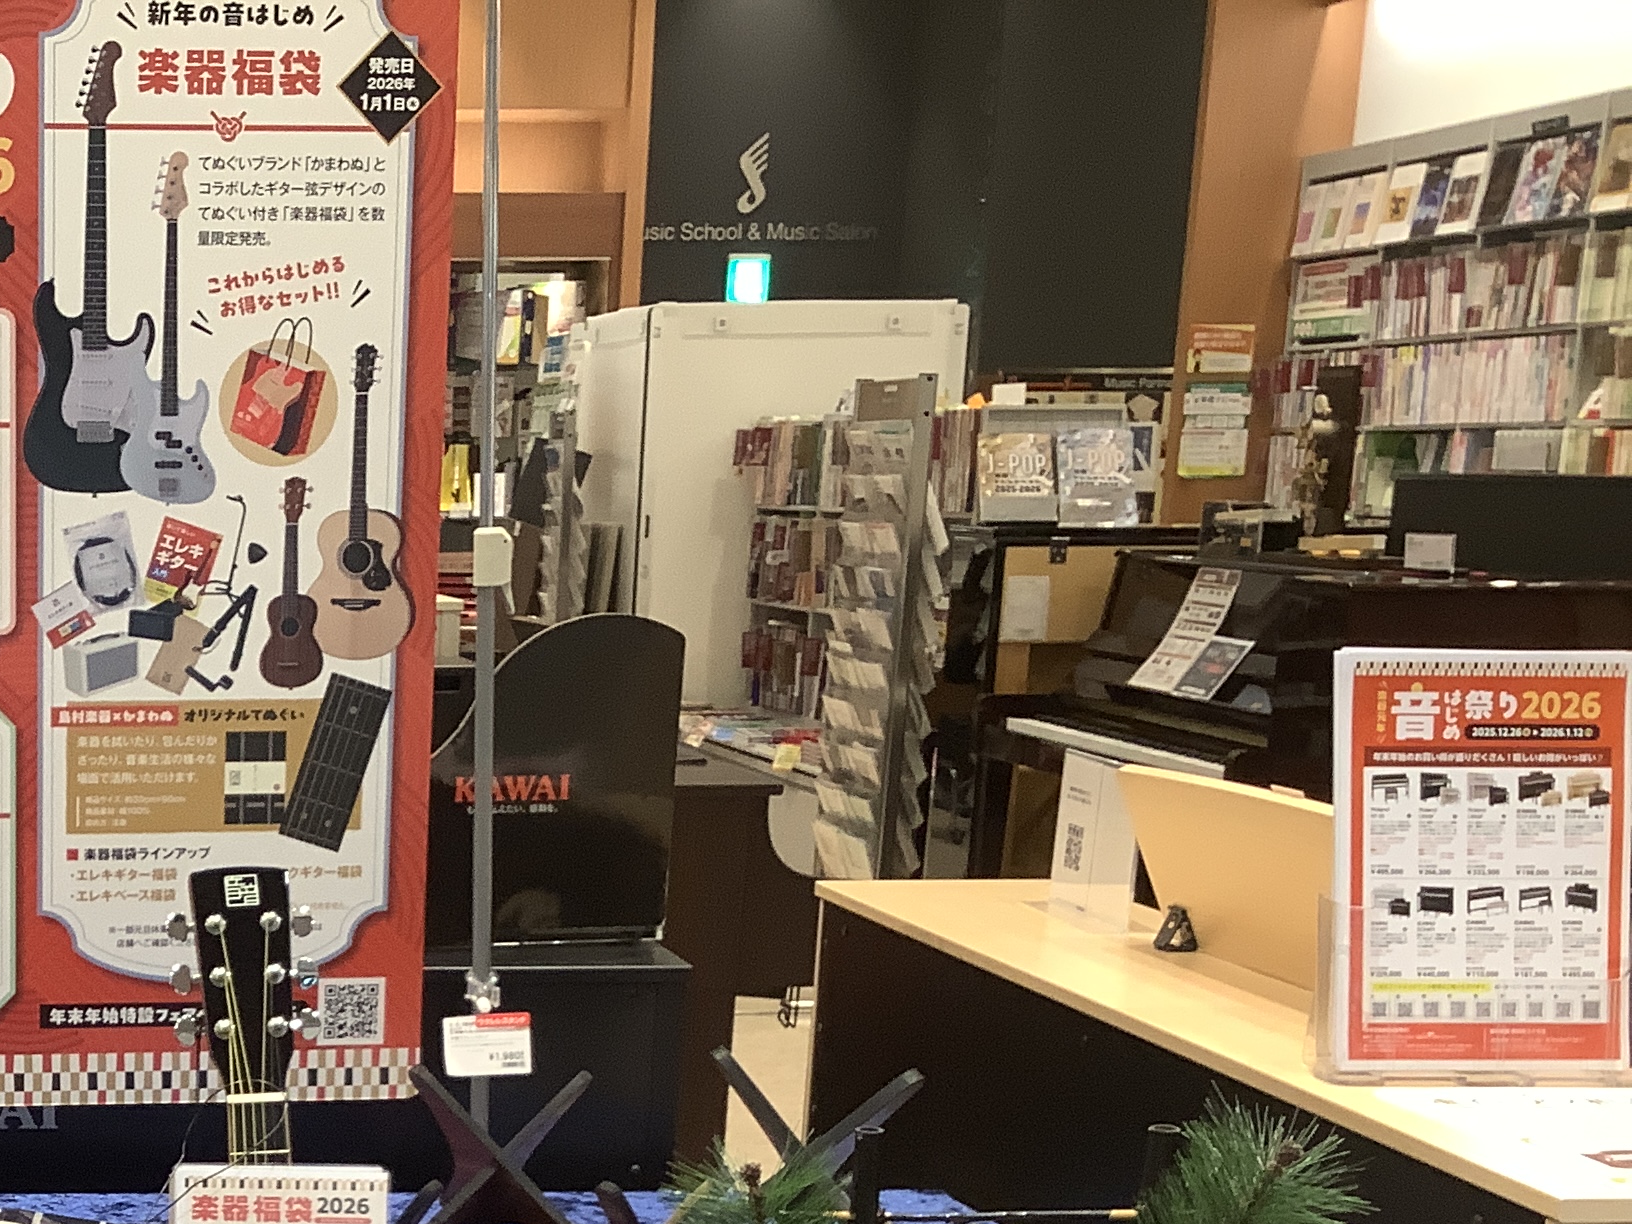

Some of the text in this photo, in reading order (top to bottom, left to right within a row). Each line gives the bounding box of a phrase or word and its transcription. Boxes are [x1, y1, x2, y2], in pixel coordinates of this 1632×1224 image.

[148, 2, 315, 26] 新年の音はじめ
[138, 48, 321, 96] 楽器福袋
[369, 58, 414, 74] 発売日
[368, 78, 416, 91] 2026年
[198, 156, 386, 173] てぬぐいブランド「かまわぬ」と
[198, 182, 386, 197] コラボしたギター弦デザインの
[198, 207, 386, 222] てぬぐい付き「楽器福袋」を数
[198, 231, 272, 247] 量限定発売。
[680, 222, 743, 241] School
[747, 222, 761, 241] &
[766, 222, 819, 241] Music
[207, 256, 346, 295] これからはじめる
[986, 452, 1047, 475] J-POP
[159, 534, 204, 559] エレキ
[156, 550, 199, 571] ギター
[184, 708, 305, 723] オリジナルてぬぐい
[1390, 689, 1441, 741] 音
[1465, 689, 1519, 720] 祭り
[1521, 690, 1602, 720] 2026
[84, 848, 211, 861] 楽器福袋ラインアップ
[191, 1194, 370, 1224] 楽器福袋 2026
